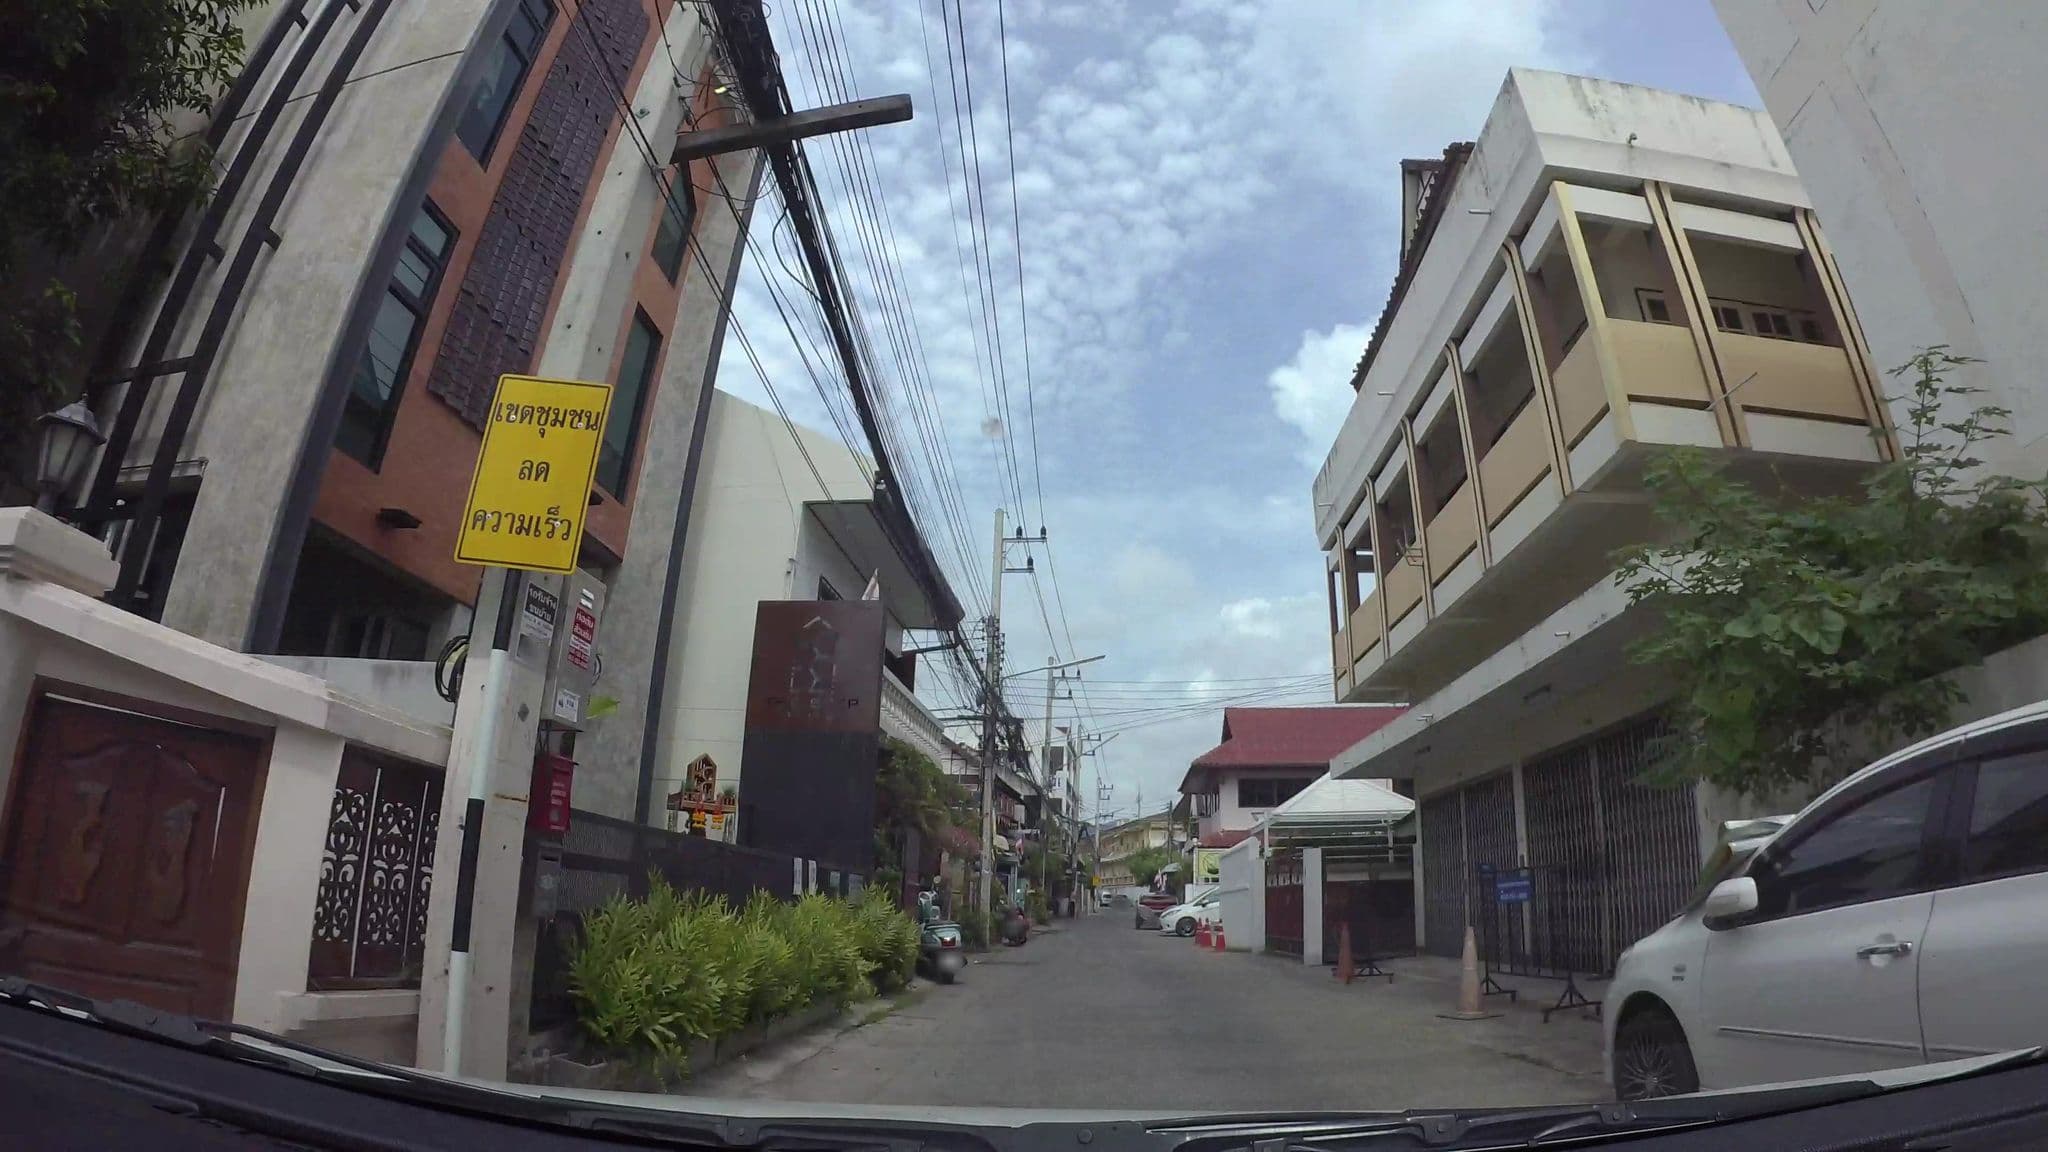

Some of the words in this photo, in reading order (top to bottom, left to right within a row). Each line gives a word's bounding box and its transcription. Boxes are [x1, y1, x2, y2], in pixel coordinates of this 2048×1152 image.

[495, 401, 601, 439] เขตชุมชน
[518, 459, 550, 483] ลด
[471, 505, 573, 541] ความเร็ว
